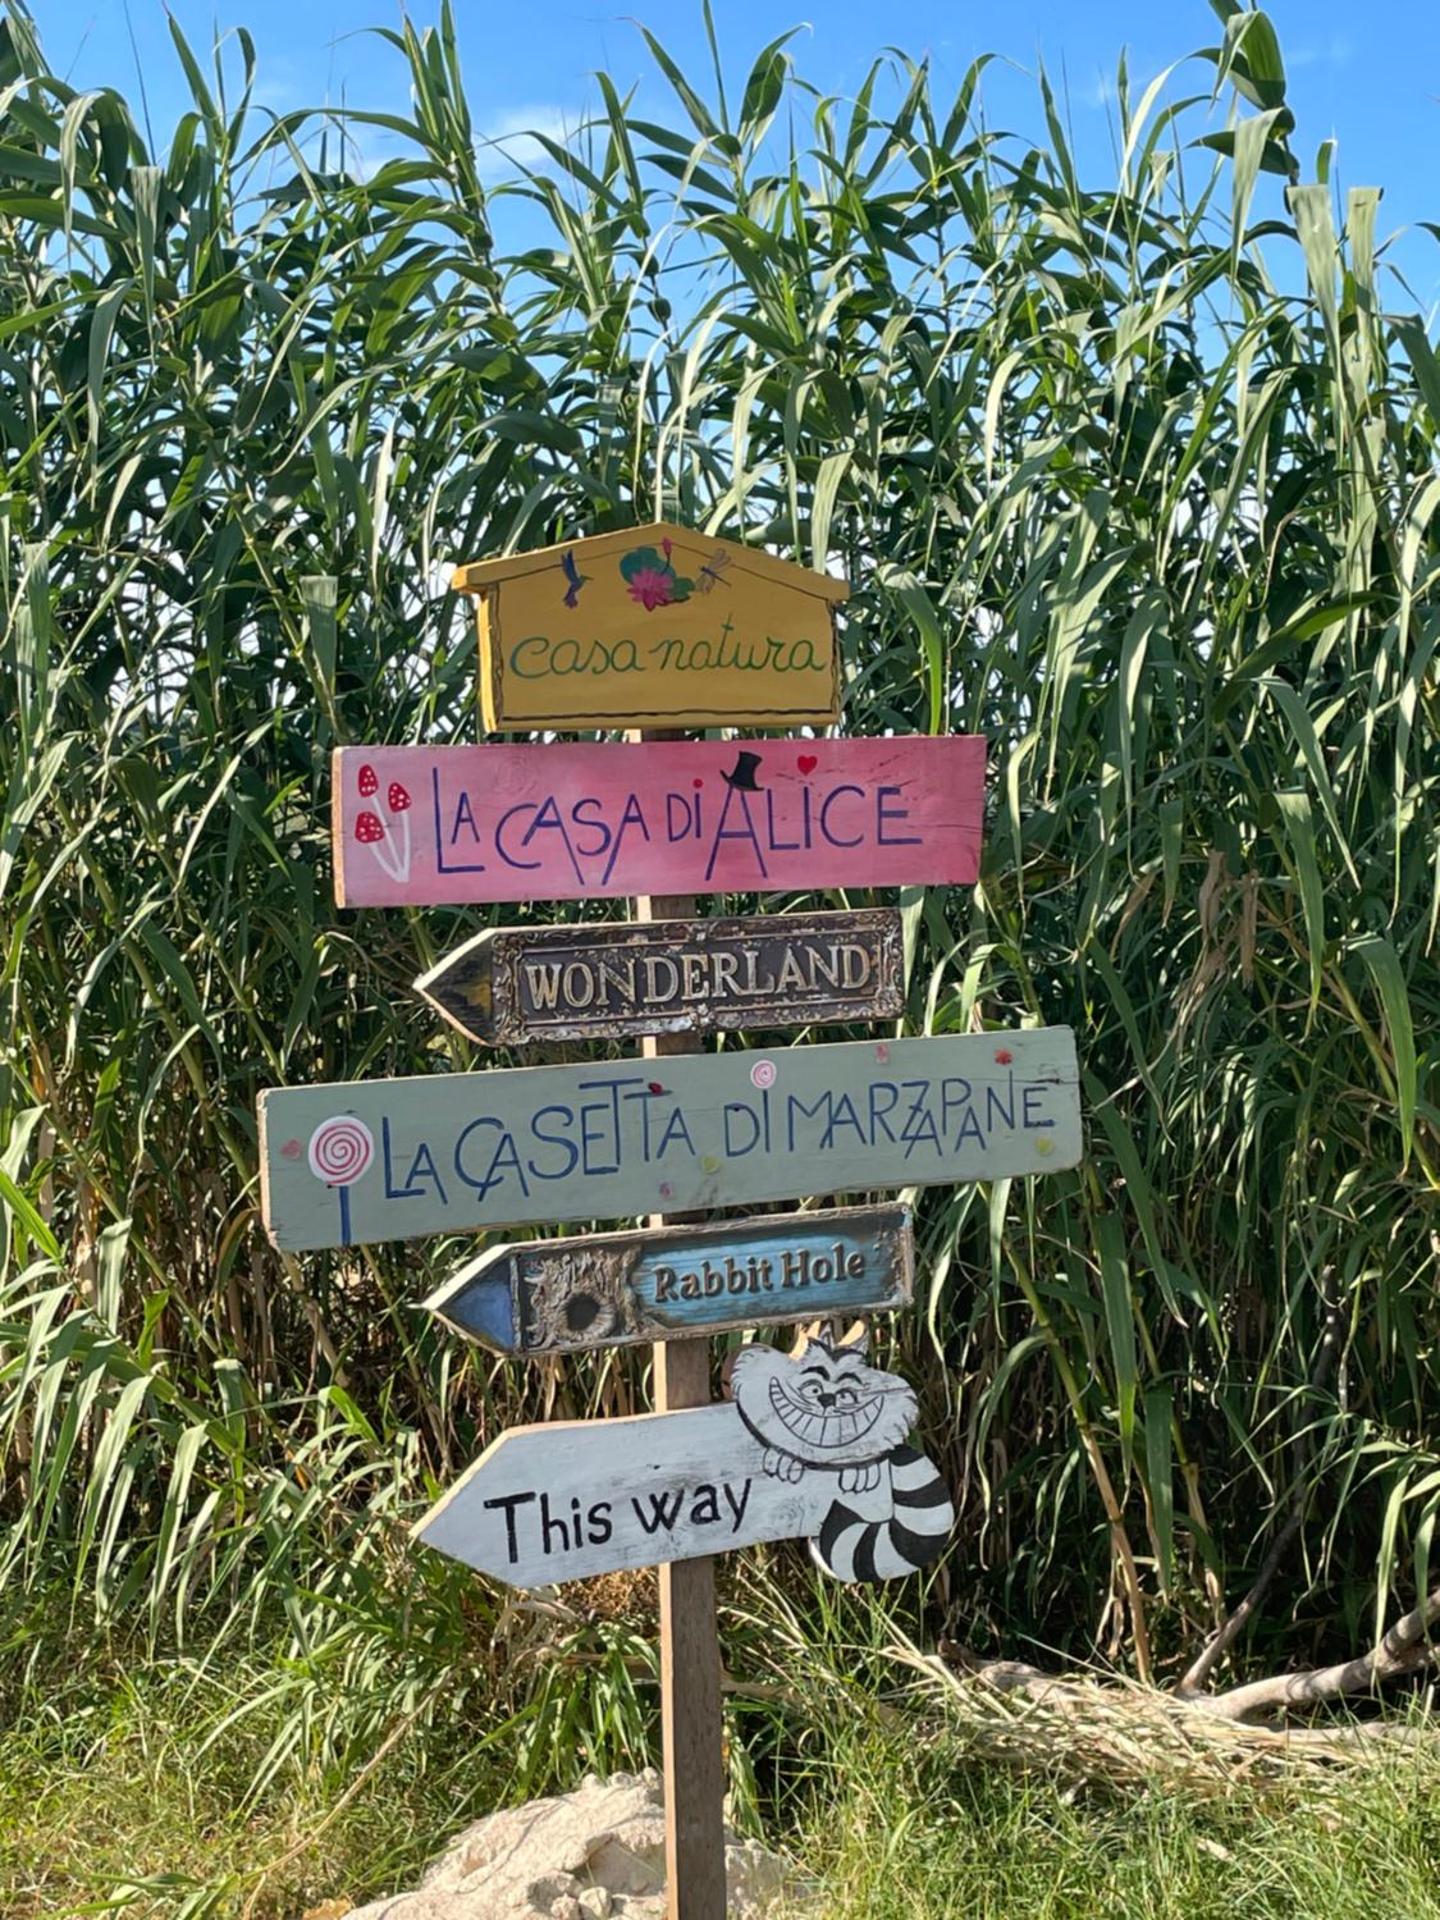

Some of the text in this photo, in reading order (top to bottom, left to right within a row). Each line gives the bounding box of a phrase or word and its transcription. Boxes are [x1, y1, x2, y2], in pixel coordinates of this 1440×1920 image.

[649, 613, 829, 673] natura
[432, 767, 485, 873] LA
[495, 794, 650, 885] CASA
[705, 785, 923, 881] ALICE
[525, 944, 870, 1009] WONDERLAND
[383, 1116, 448, 1201] LA
[452, 1078, 696, 1201] CASETTA
[786, 1068, 1056, 1158] MARZAPANE
[652, 1242, 867, 1303] Rabbit Hole
[484, 1478, 753, 1564] This way
